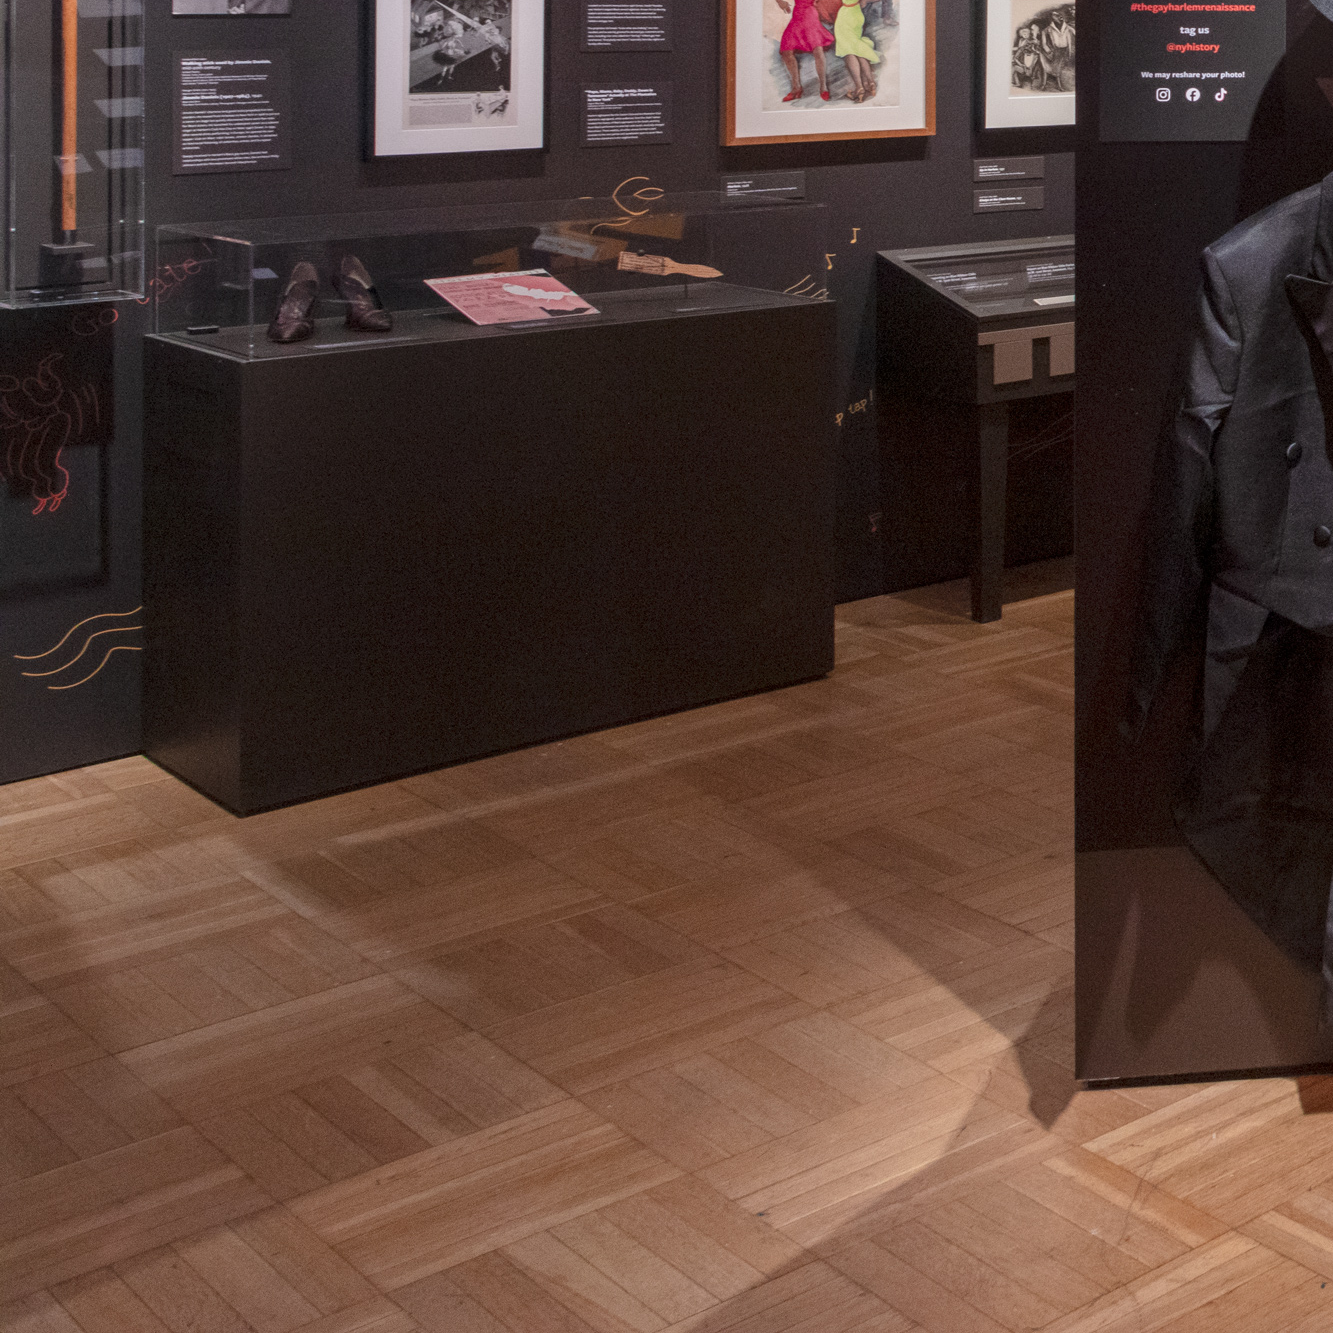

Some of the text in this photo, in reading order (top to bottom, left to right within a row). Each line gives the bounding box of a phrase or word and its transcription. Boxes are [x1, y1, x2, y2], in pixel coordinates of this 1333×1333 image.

[1130, 3, 1256, 13] #thegayharlemrenaissance
[1180, 26, 1196, 36] tag
[1166, 43, 1220, 53] @nyhistory
